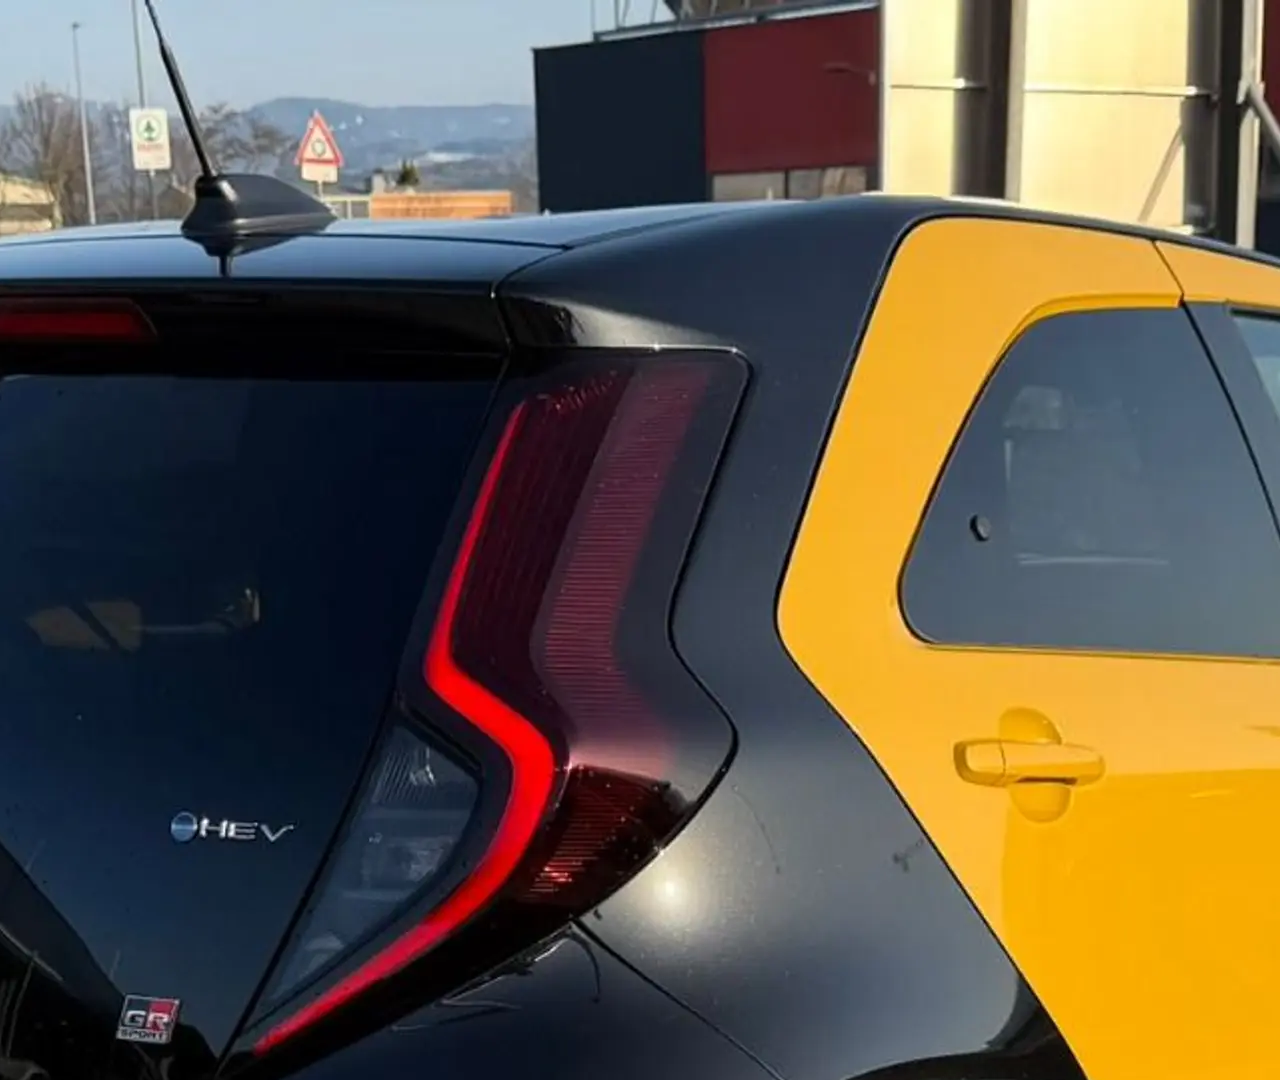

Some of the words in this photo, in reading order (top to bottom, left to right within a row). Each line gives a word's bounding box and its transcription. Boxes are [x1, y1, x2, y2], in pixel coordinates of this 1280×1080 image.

[199, 816, 295, 842] HEV
[124, 1010, 170, 1032] GR
[120, 1028, 165, 1040] SPORT
